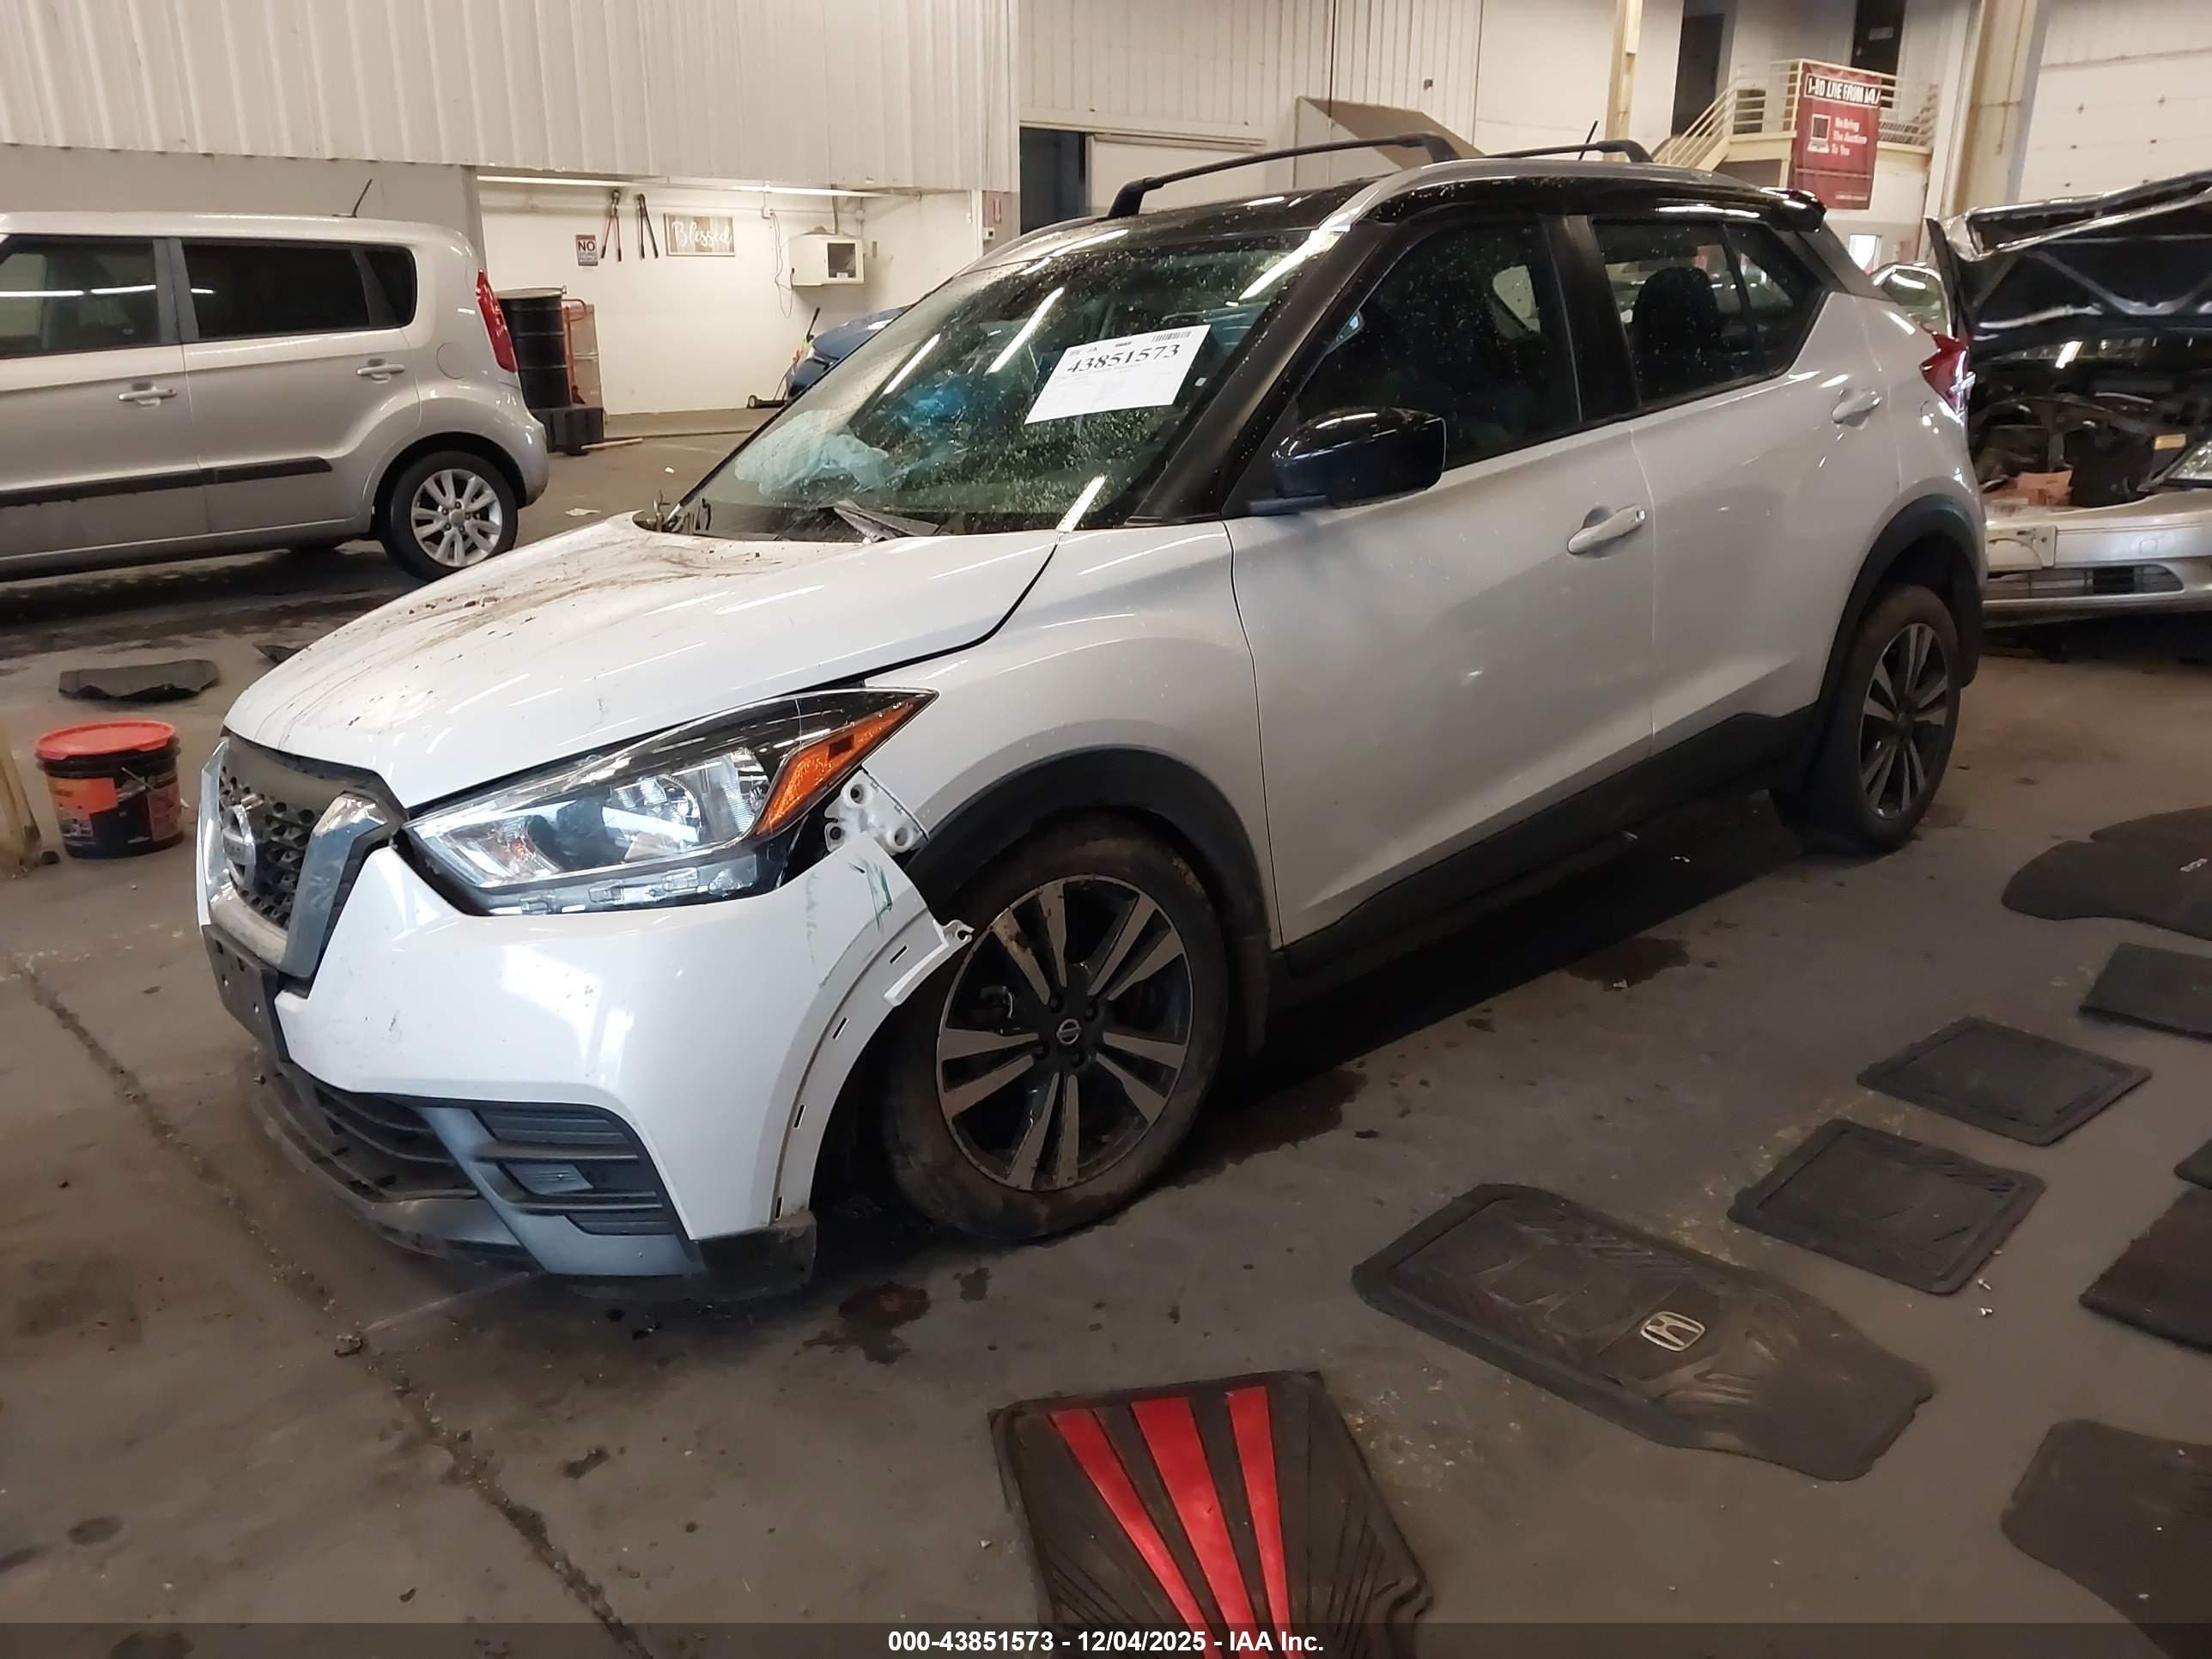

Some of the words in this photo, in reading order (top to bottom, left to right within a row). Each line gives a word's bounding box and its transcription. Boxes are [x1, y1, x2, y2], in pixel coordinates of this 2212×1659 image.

[578, 240, 595, 252] NO
[672, 221, 732, 247] Blessed
[1066, 344, 1180, 373] 43851573
